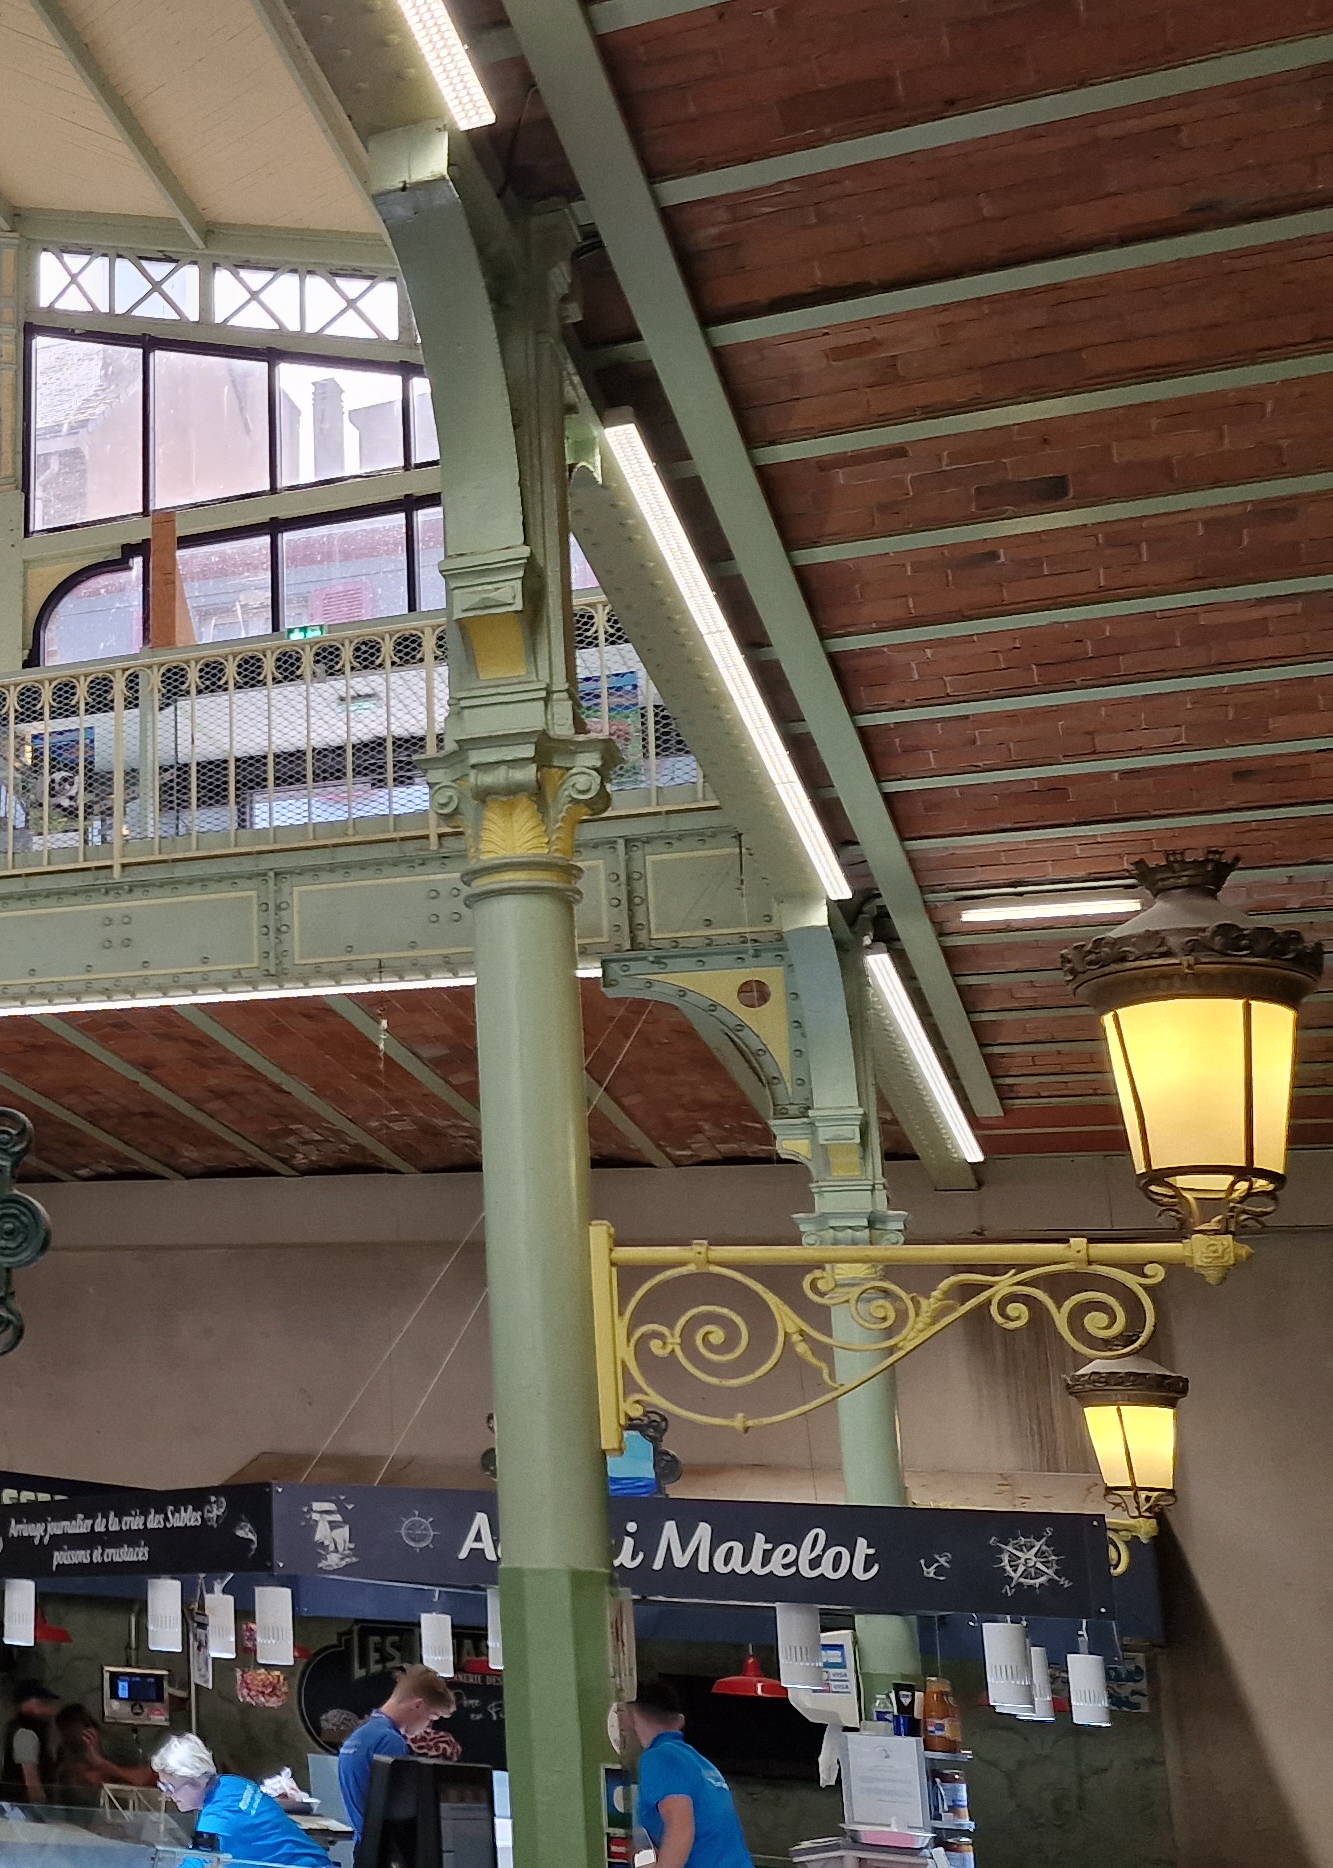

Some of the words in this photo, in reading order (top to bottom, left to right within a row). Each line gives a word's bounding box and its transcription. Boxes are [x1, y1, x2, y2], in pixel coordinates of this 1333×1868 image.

[9, 1517, 46, 1545] Arrivage
[43, 1514, 92, 1545] journalier
[94, 1512, 107, 1532] de
[108, 1511, 120, 1531] la
[121, 1509, 145, 1532] criée
[146, 1508, 164, 1531] des
[166, 1504, 202, 1530] Sables
[52, 1545, 90, 1571] poissons
[92, 1545, 102, 1563] et
[103, 1539, 149, 1563] crustacés
[652, 1520, 880, 1581] Matelot
